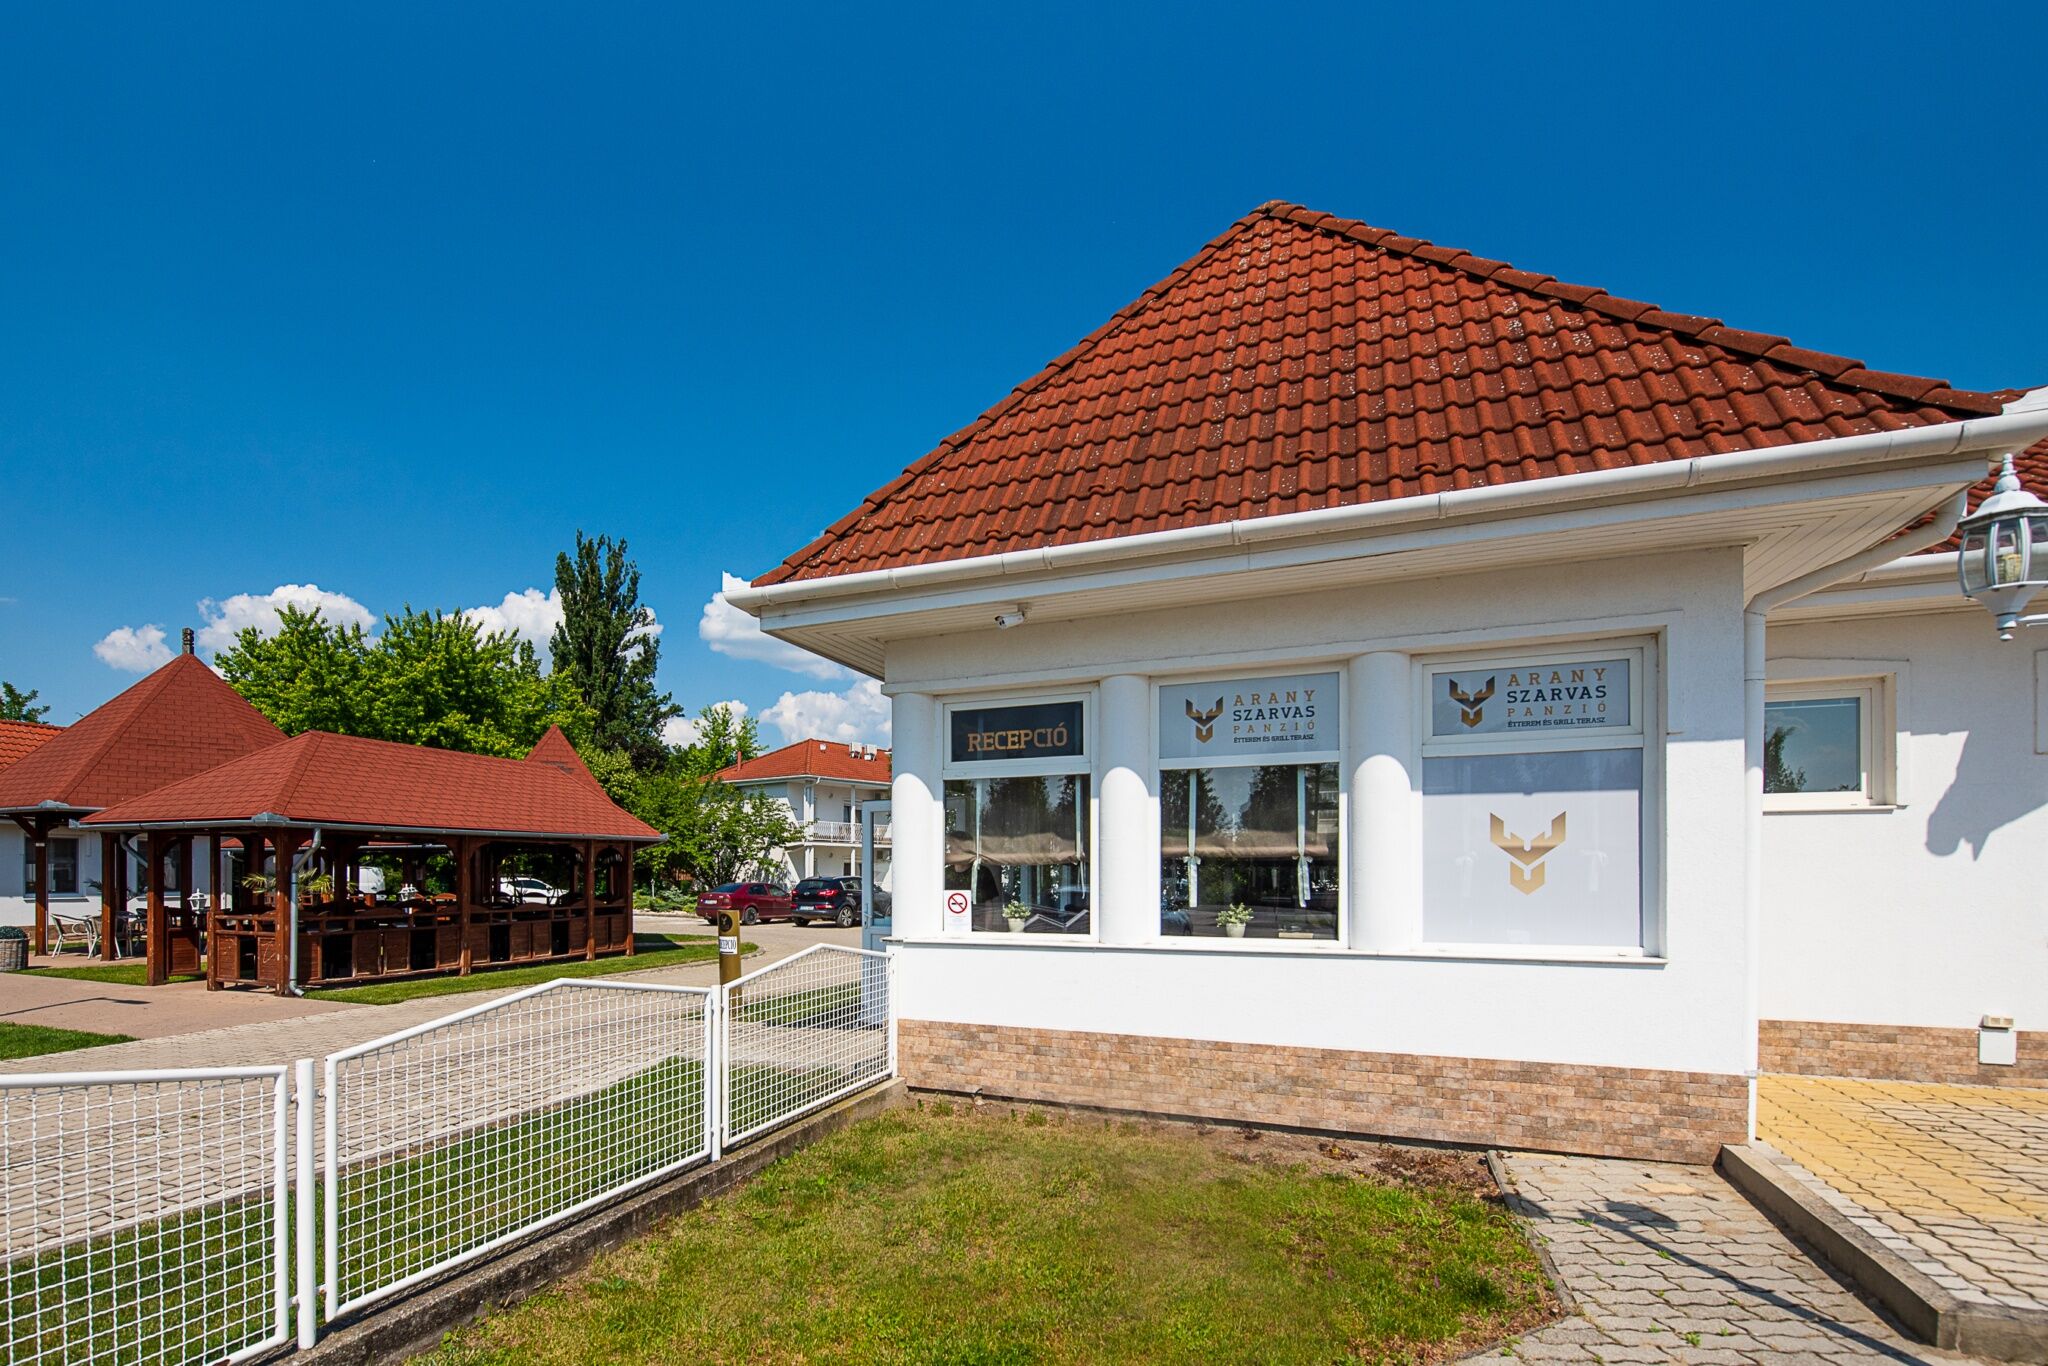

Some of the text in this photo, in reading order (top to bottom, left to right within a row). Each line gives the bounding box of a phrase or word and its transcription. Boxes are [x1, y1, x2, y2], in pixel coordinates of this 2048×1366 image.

[1507, 668, 1606, 687] ARANY
[1233, 690, 1315, 706] ARANY
[1507, 685, 1607, 703] SZARVAS
[1233, 705, 1315, 721] SZARVAS
[1507, 701, 1606, 717] PANZIÓ
[1233, 720, 1315, 733] PANZIÓ
[1543, 718, 1552, 726] ÉS
[967, 722, 1068, 751] RECEPCIÓ
